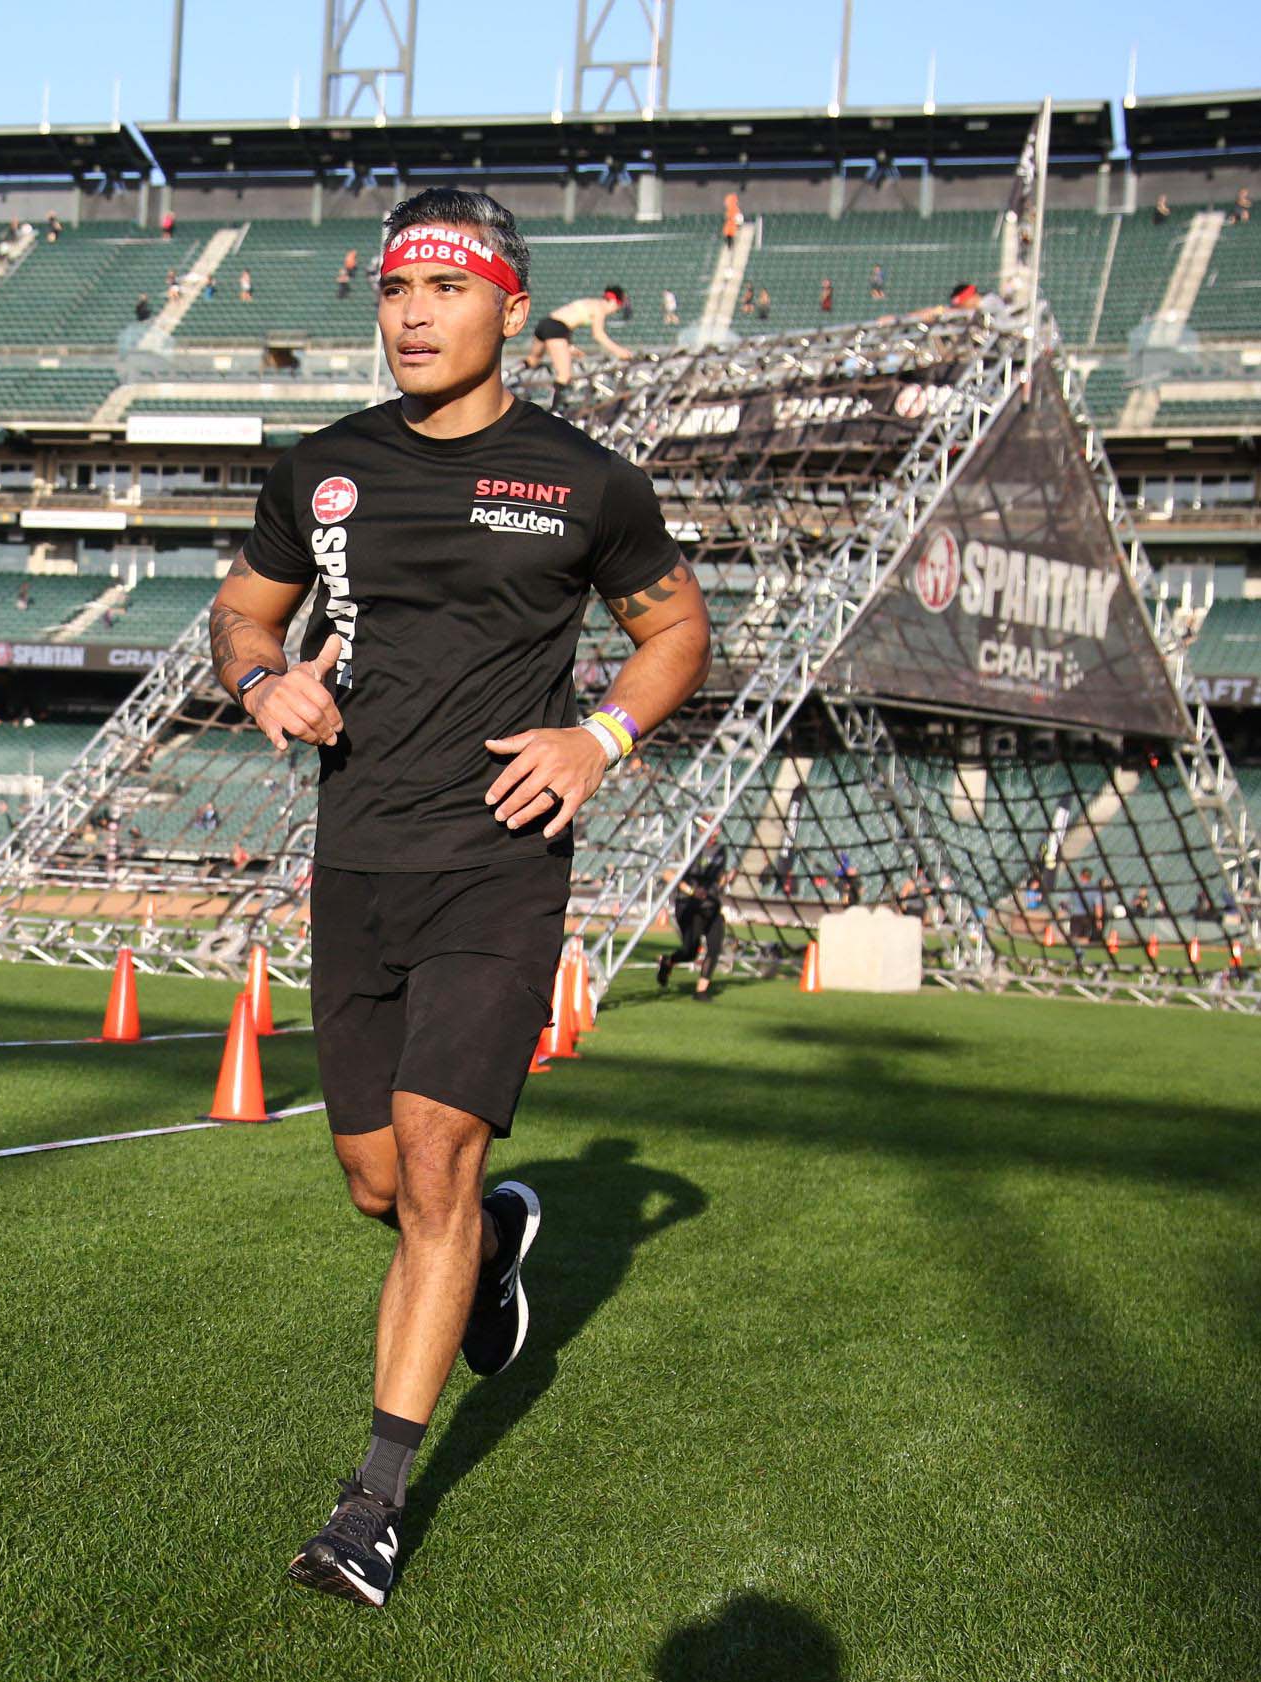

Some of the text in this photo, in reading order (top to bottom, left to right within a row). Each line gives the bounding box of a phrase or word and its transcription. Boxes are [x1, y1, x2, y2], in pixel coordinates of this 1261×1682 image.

[403, 243, 468, 266] 4086
[408, 227, 494, 263] SPARTAN
[475, 479, 571, 505] SPRINT
[469, 505, 565, 537] Rakuten
[959, 540, 1122, 641] SPARTAN
[978, 639, 1064, 684] CRAFT
